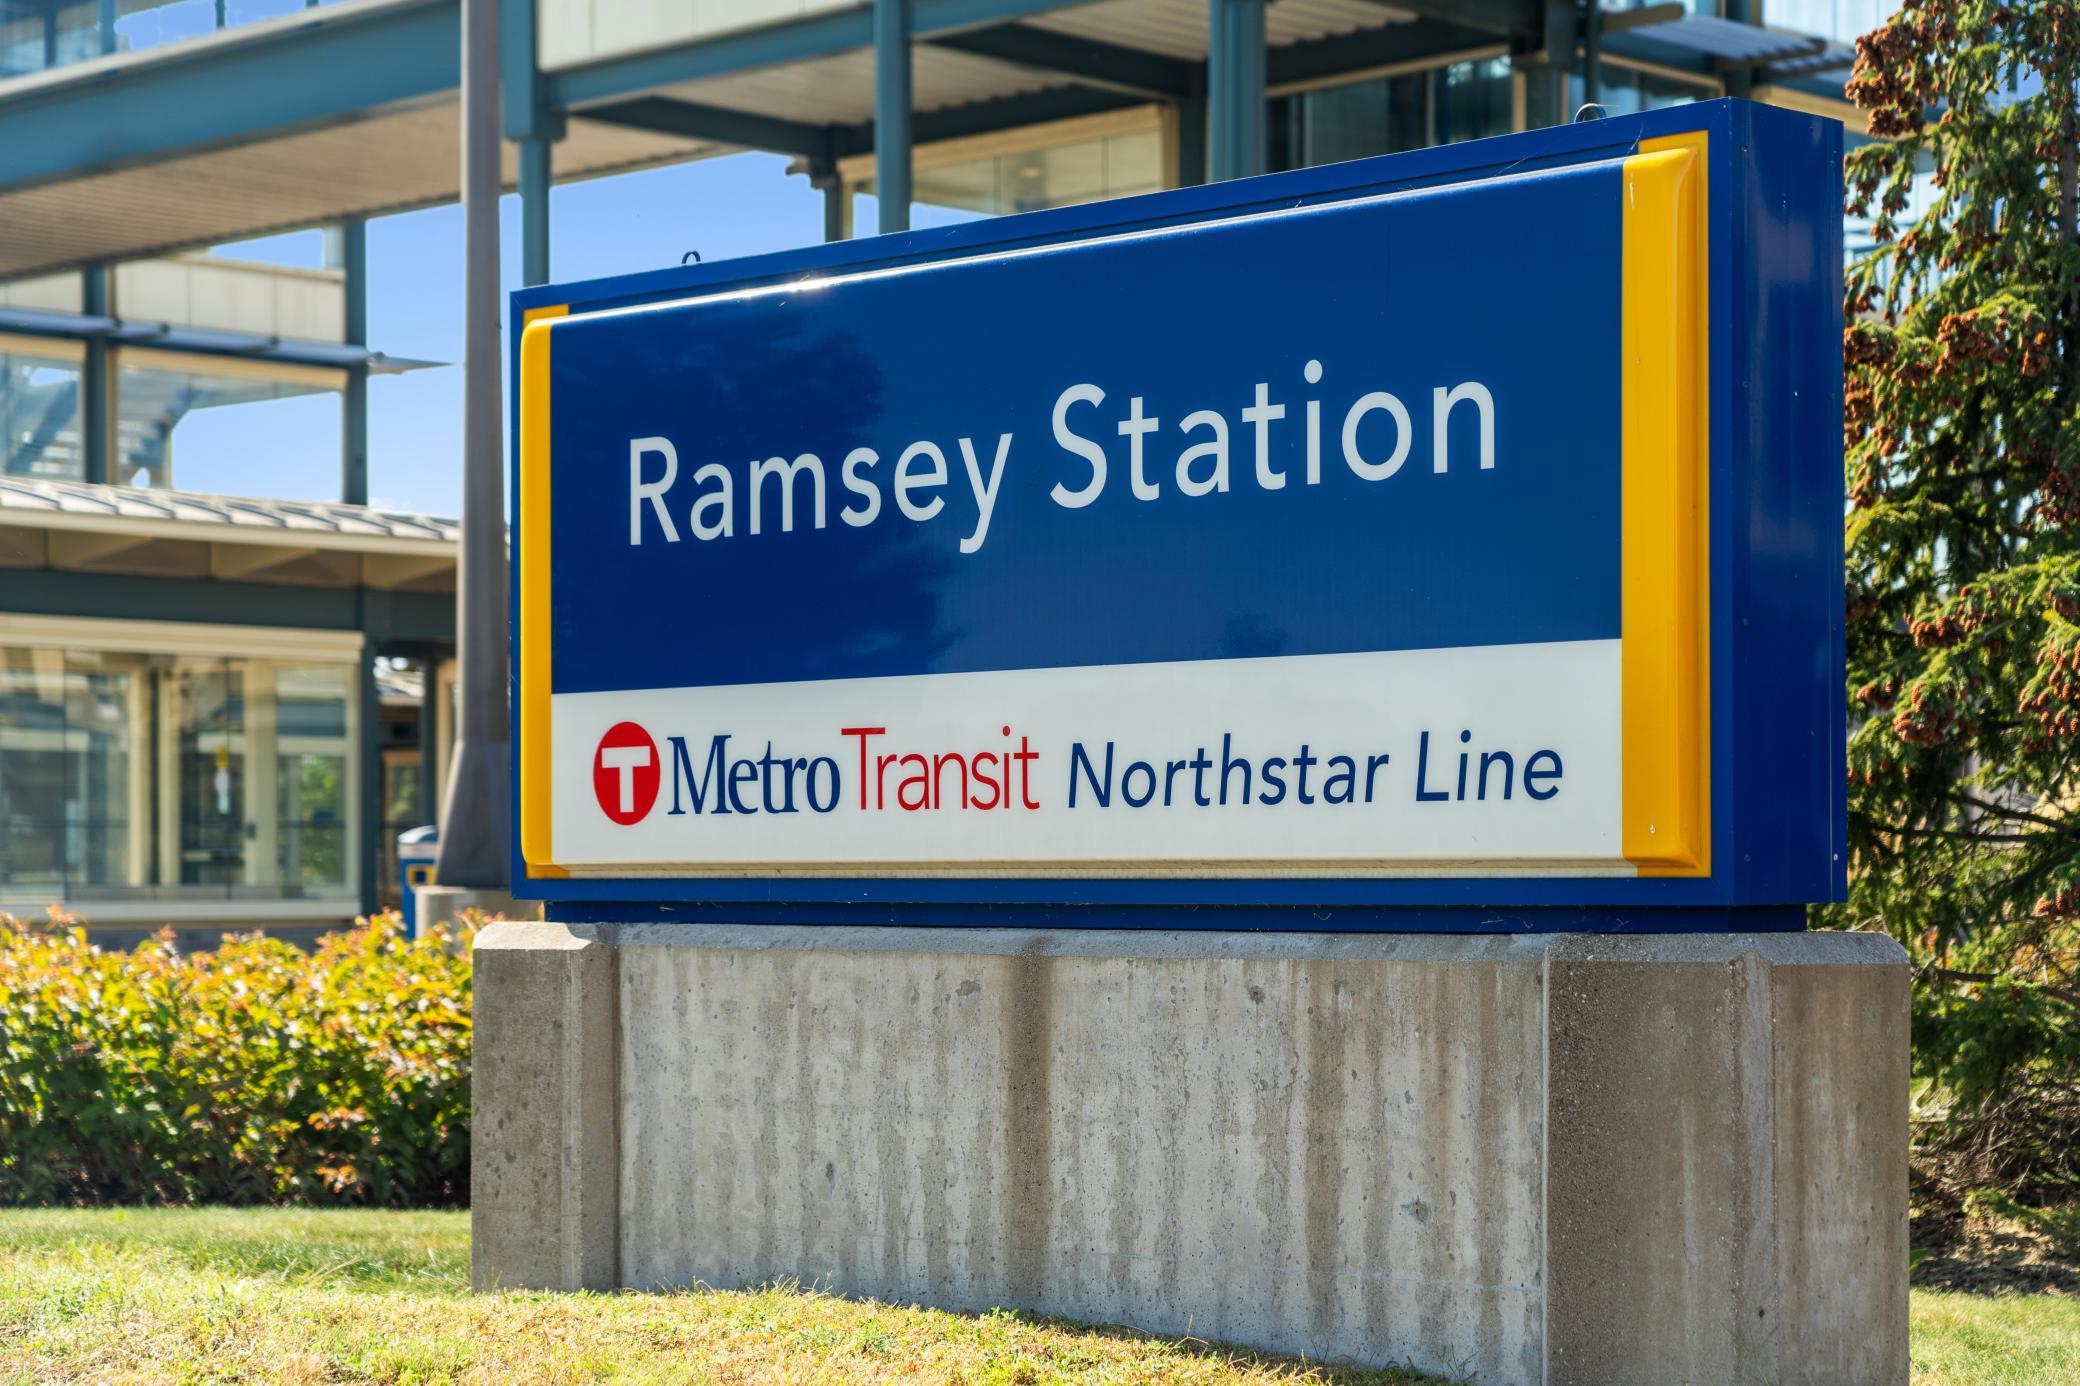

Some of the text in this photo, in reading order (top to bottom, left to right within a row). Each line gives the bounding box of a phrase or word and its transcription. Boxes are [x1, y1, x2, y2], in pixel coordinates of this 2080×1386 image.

[629, 359, 1496, 554] Ramsey Station
[1068, 731, 1390, 808] Northstar
[1415, 729, 1564, 802] Line
